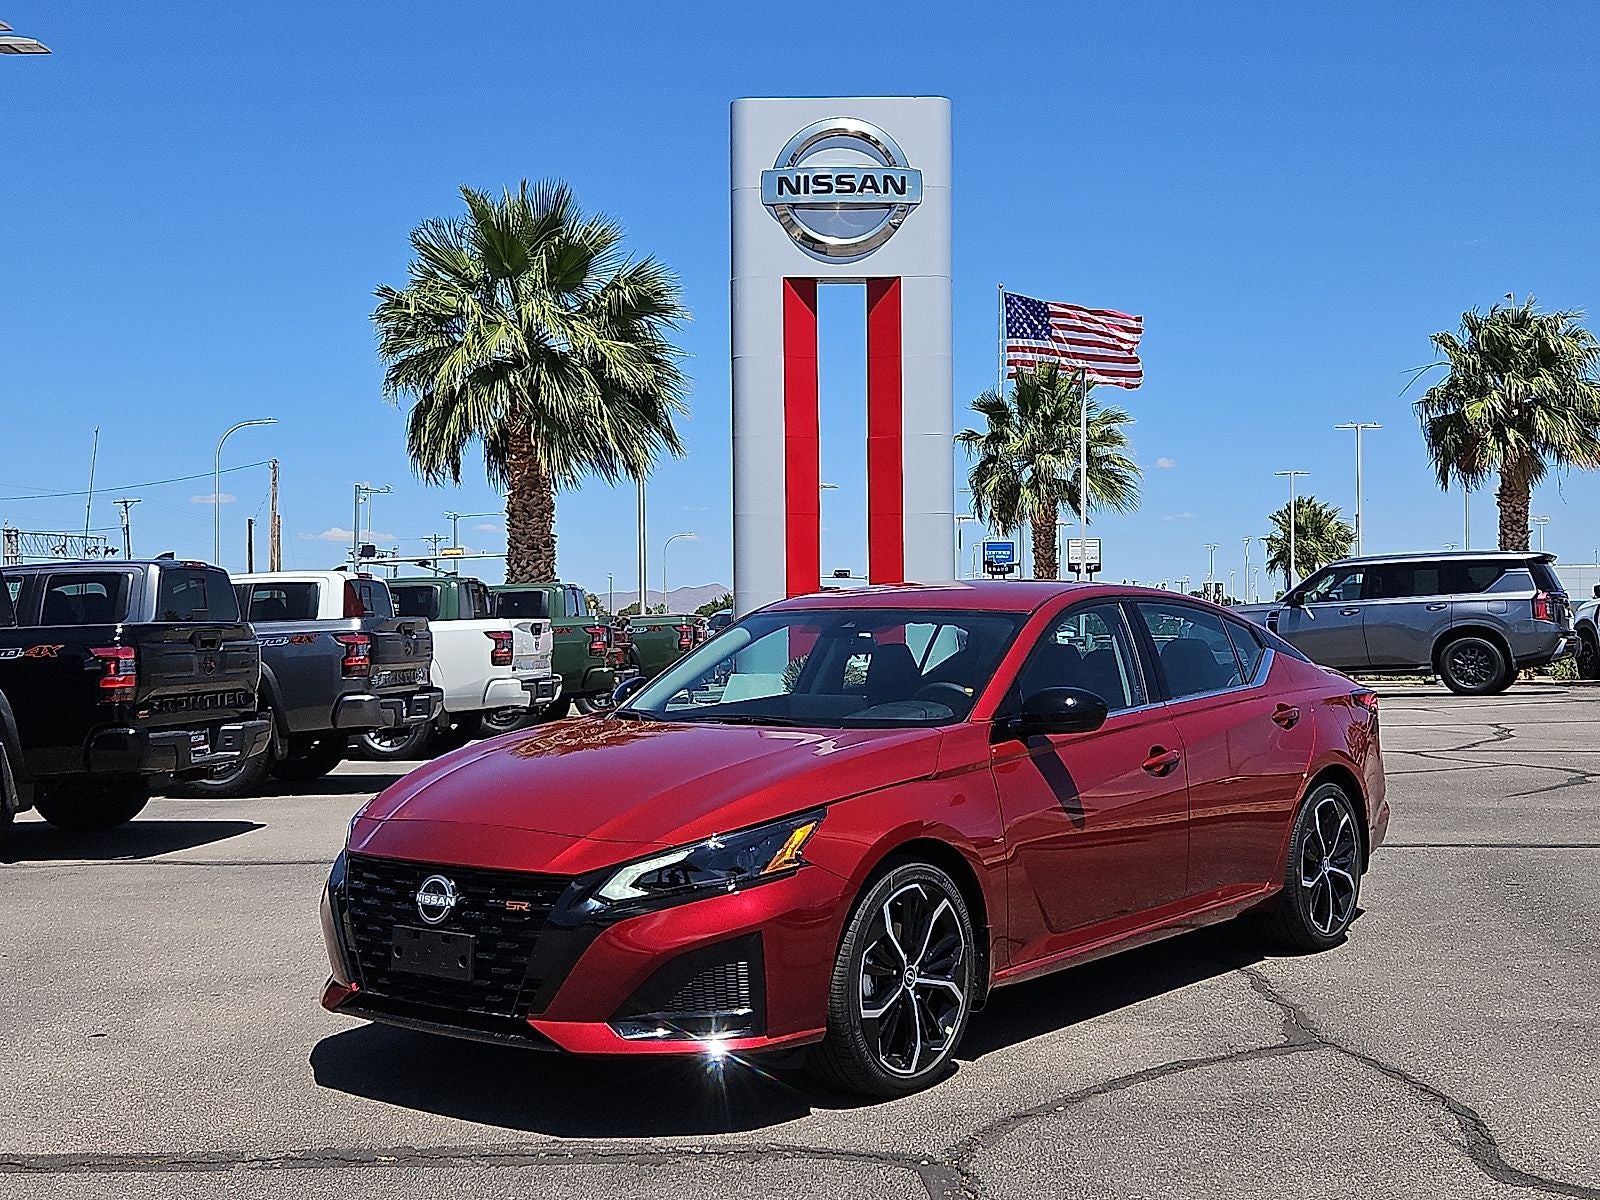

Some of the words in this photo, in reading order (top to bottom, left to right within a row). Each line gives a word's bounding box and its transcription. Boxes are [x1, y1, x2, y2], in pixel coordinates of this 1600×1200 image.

[777, 174, 907, 196] NISSAN
[149, 691, 247, 712] FRONTIER
[416, 893, 455, 907] NISSAN
[505, 900, 530, 911] SR
